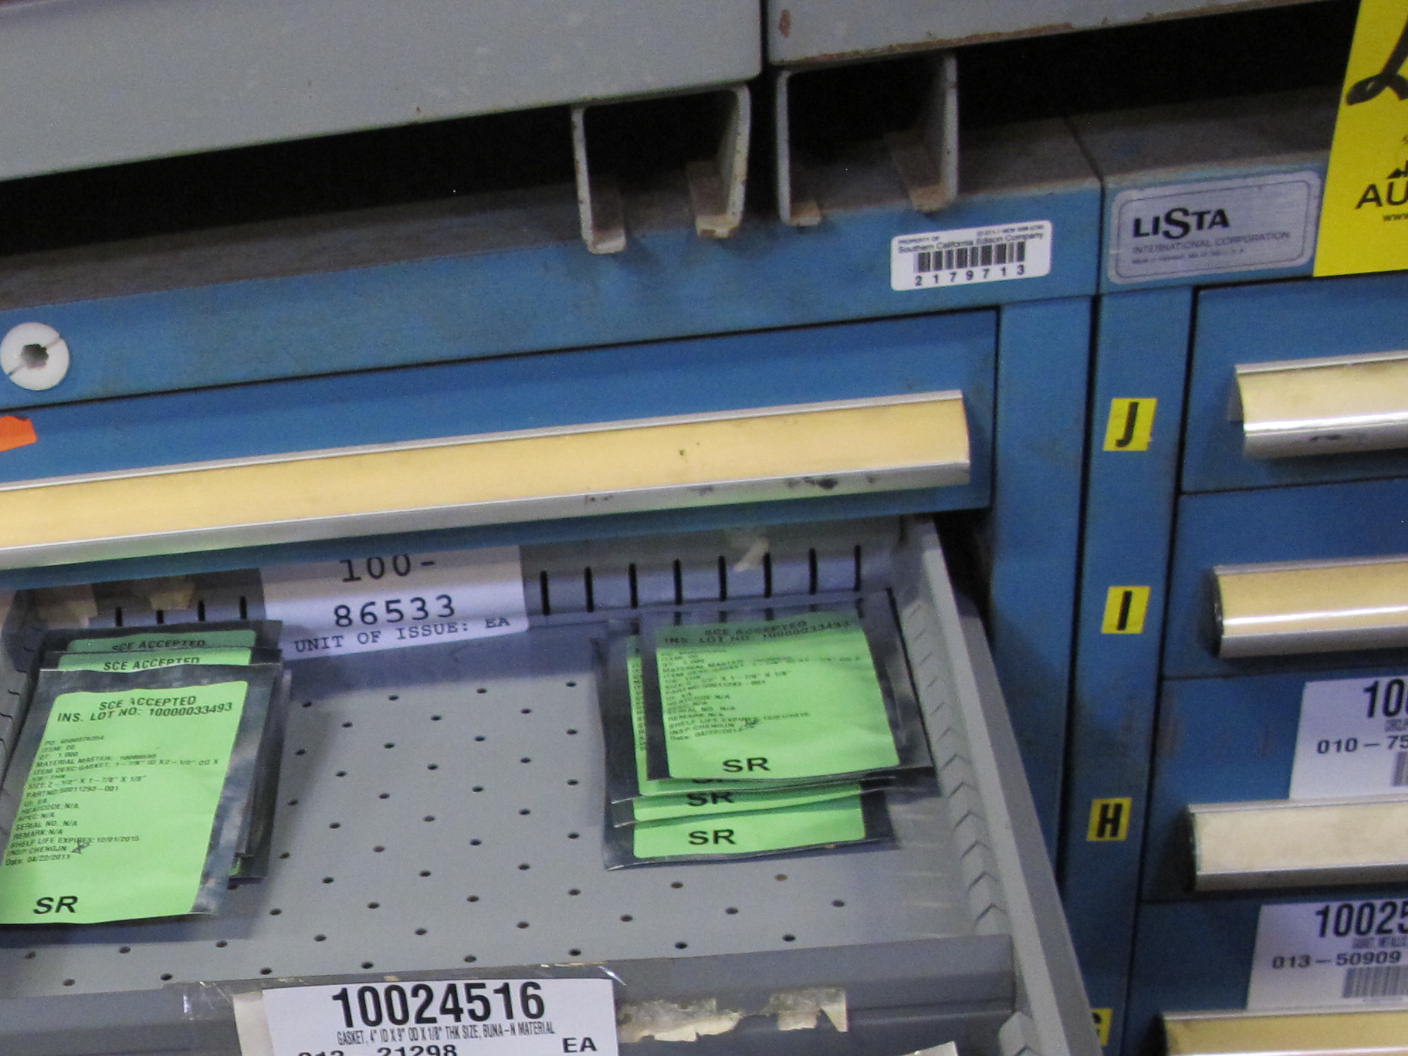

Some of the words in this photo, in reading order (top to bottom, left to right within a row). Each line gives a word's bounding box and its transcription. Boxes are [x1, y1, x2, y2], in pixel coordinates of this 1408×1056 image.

[1133, 207, 1230, 239] LISTA
[1116, 401, 1139, 447] J
[339, 553, 435, 583] 100-
[334, 594, 455, 628] 86533
[294, 635, 344, 653] UNIT
[357, 630, 381, 645] OF
[396, 621, 469, 640] ISSUE:
[485, 617, 511, 629] EA
[104, 661, 127, 671] SCE
[90, 710, 113, 721] LOT
[99, 700, 122, 711] SCE
[722, 757, 770, 772] SR
[686, 791, 734, 806] SR
[1096, 803, 1124, 838] H
[688, 829, 736, 845] SR
[33, 895, 78, 914] SR
[332, 981, 545, 1028] 10024516
[337, 1030, 368, 1045] GASKET,
[380, 1030, 389, 1042] ID
[391, 1030, 397, 1042] X
[421, 1029, 426, 1040] X
[446, 1026, 461, 1040] THK
[517, 1021, 555, 1035] MATERIAL
[562, 1037, 597, 1054] EA
